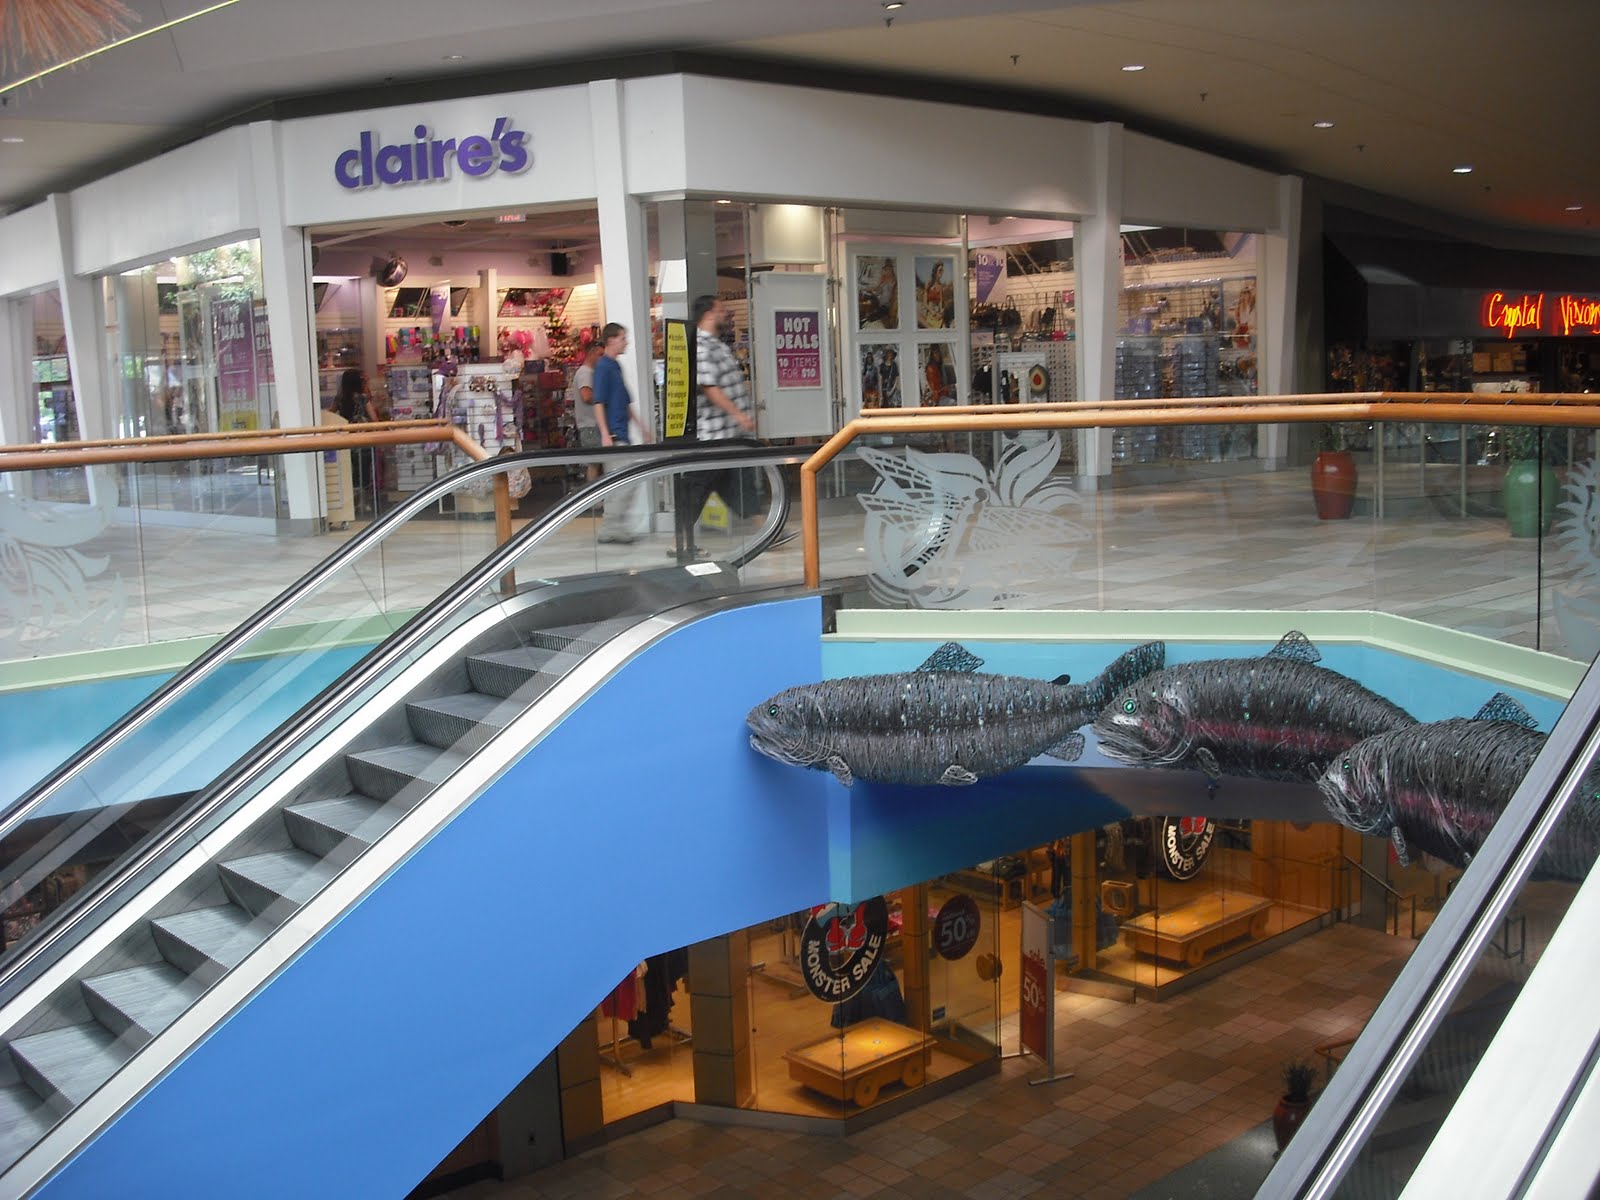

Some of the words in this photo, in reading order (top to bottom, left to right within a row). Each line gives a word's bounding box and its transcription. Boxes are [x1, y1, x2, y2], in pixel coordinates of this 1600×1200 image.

[335, 117, 530, 189] claire's
[783, 317, 811, 333] HOT
[1488, 293, 1544, 339] Crystal
[776, 334, 819, 349] DEALS
[778, 357, 789, 368] 10
[792, 357, 817, 367] ITEMS
[782, 368, 798, 378] FOR
[801, 367, 816, 378] $10
[1167, 825, 1195, 871] MONSTER
[1196, 822, 1216, 860] SALE
[807, 940, 851, 995] MONSTER
[852, 934, 882, 981] SALE
